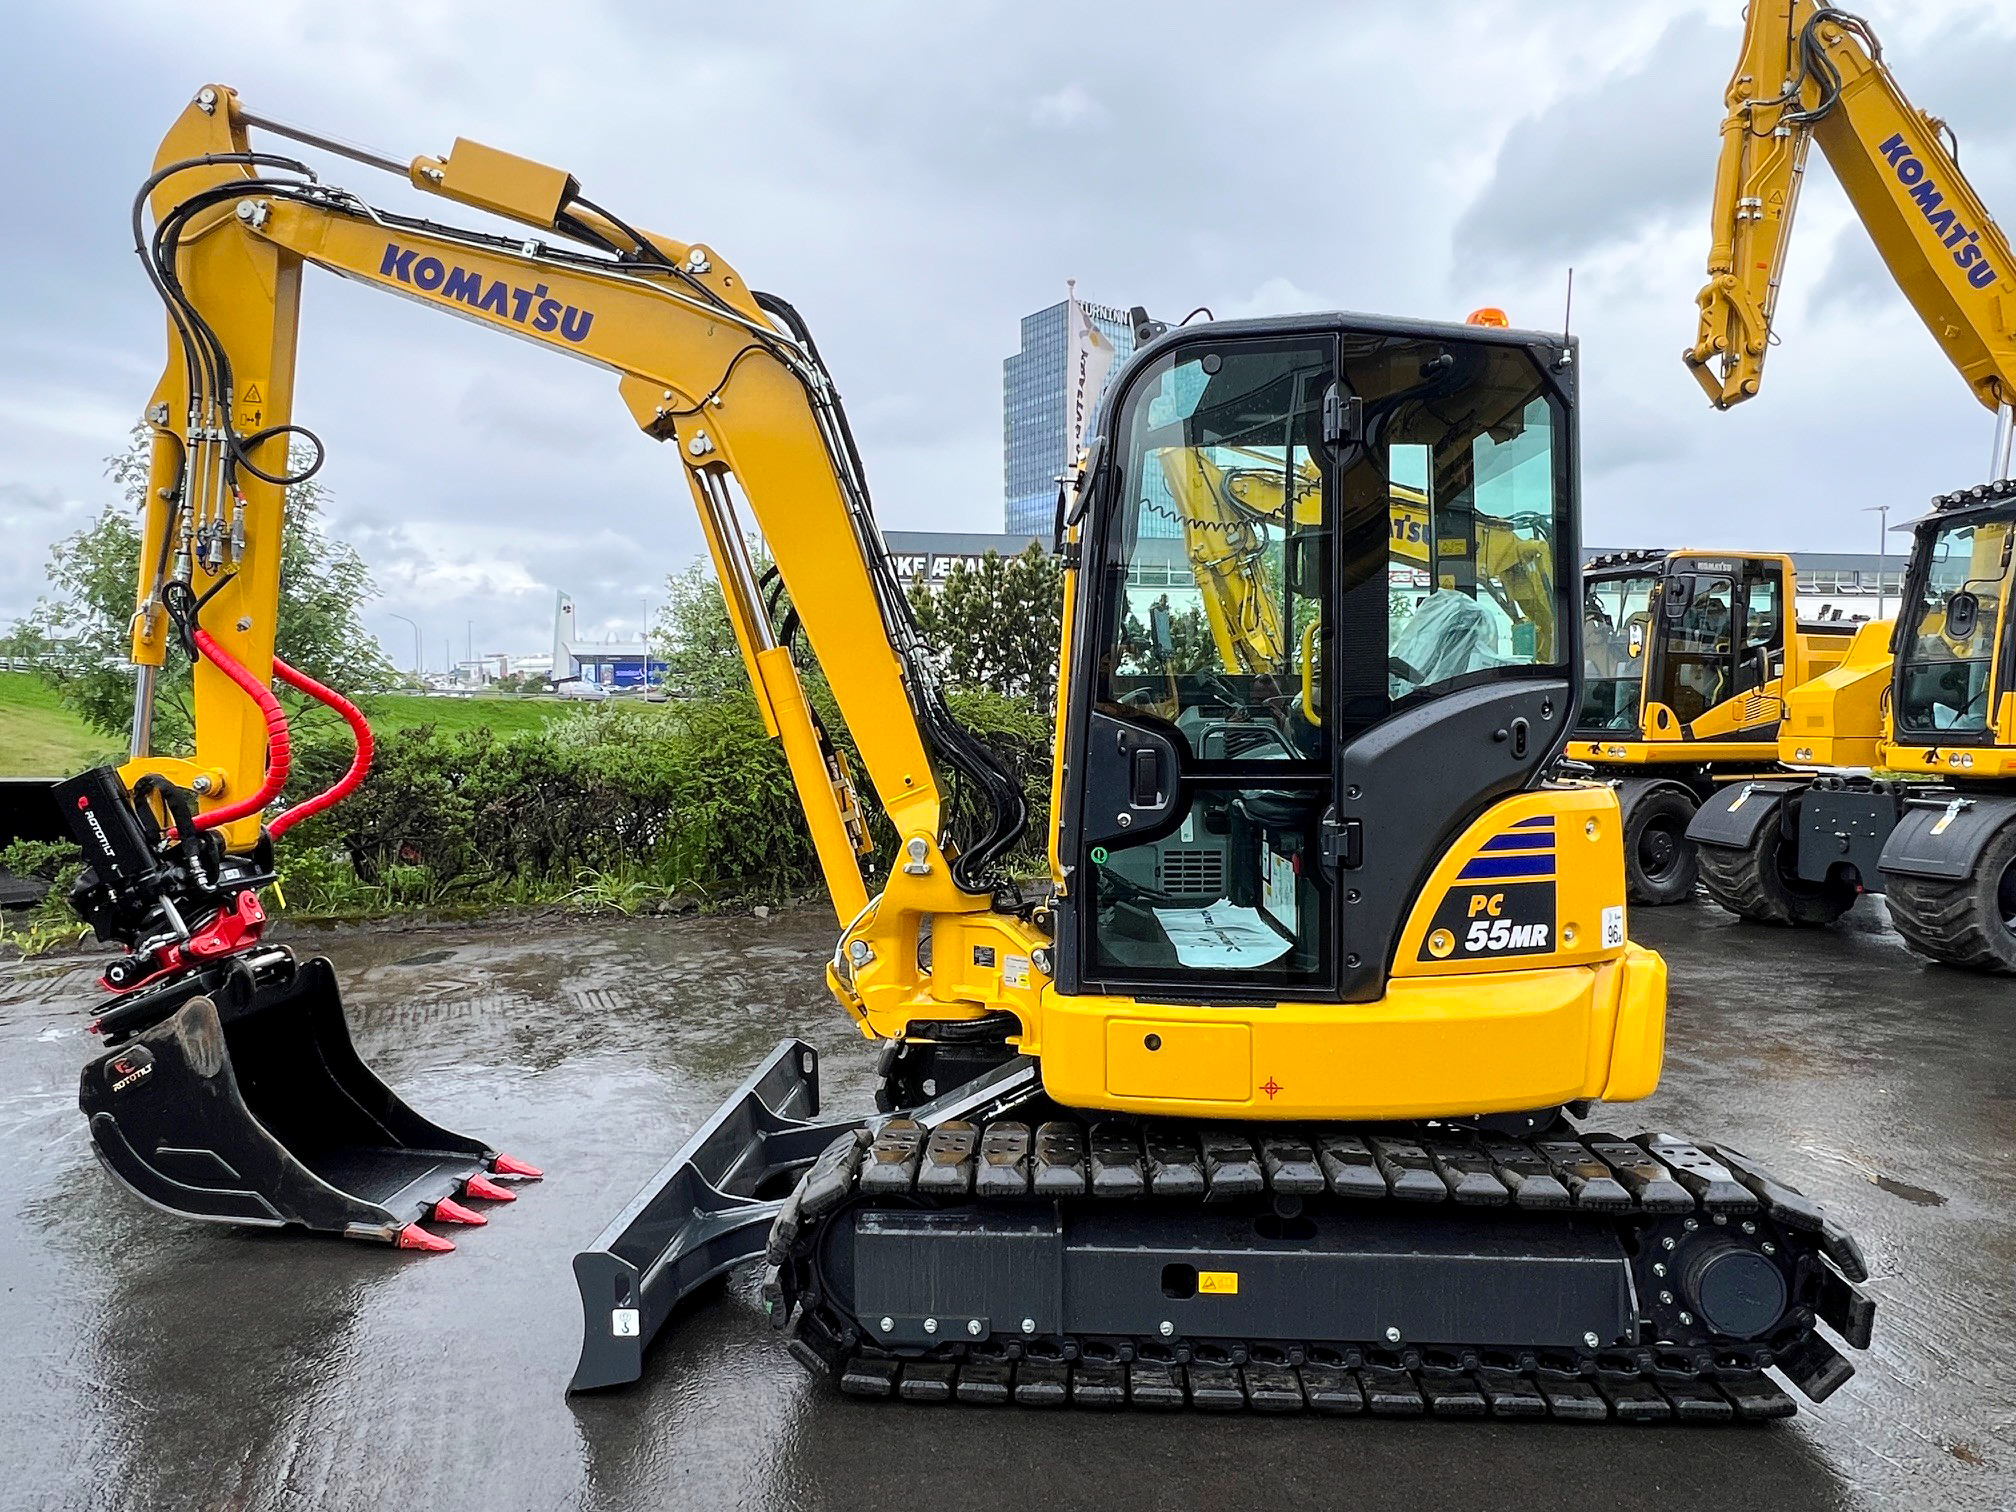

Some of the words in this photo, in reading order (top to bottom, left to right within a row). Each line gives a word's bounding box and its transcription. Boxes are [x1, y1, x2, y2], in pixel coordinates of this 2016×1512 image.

[1878, 132, 1998, 289] KOMATSU
[379, 243, 595, 343] KOMATSU
[1697, 561, 1732, 572] KOMATSU
[85, 810, 116, 857] ROTOTILT
[1467, 893, 1504, 918] PC
[1464, 918, 1550, 952] 55MR
[112, 1062, 153, 1093] ROTOTILT
